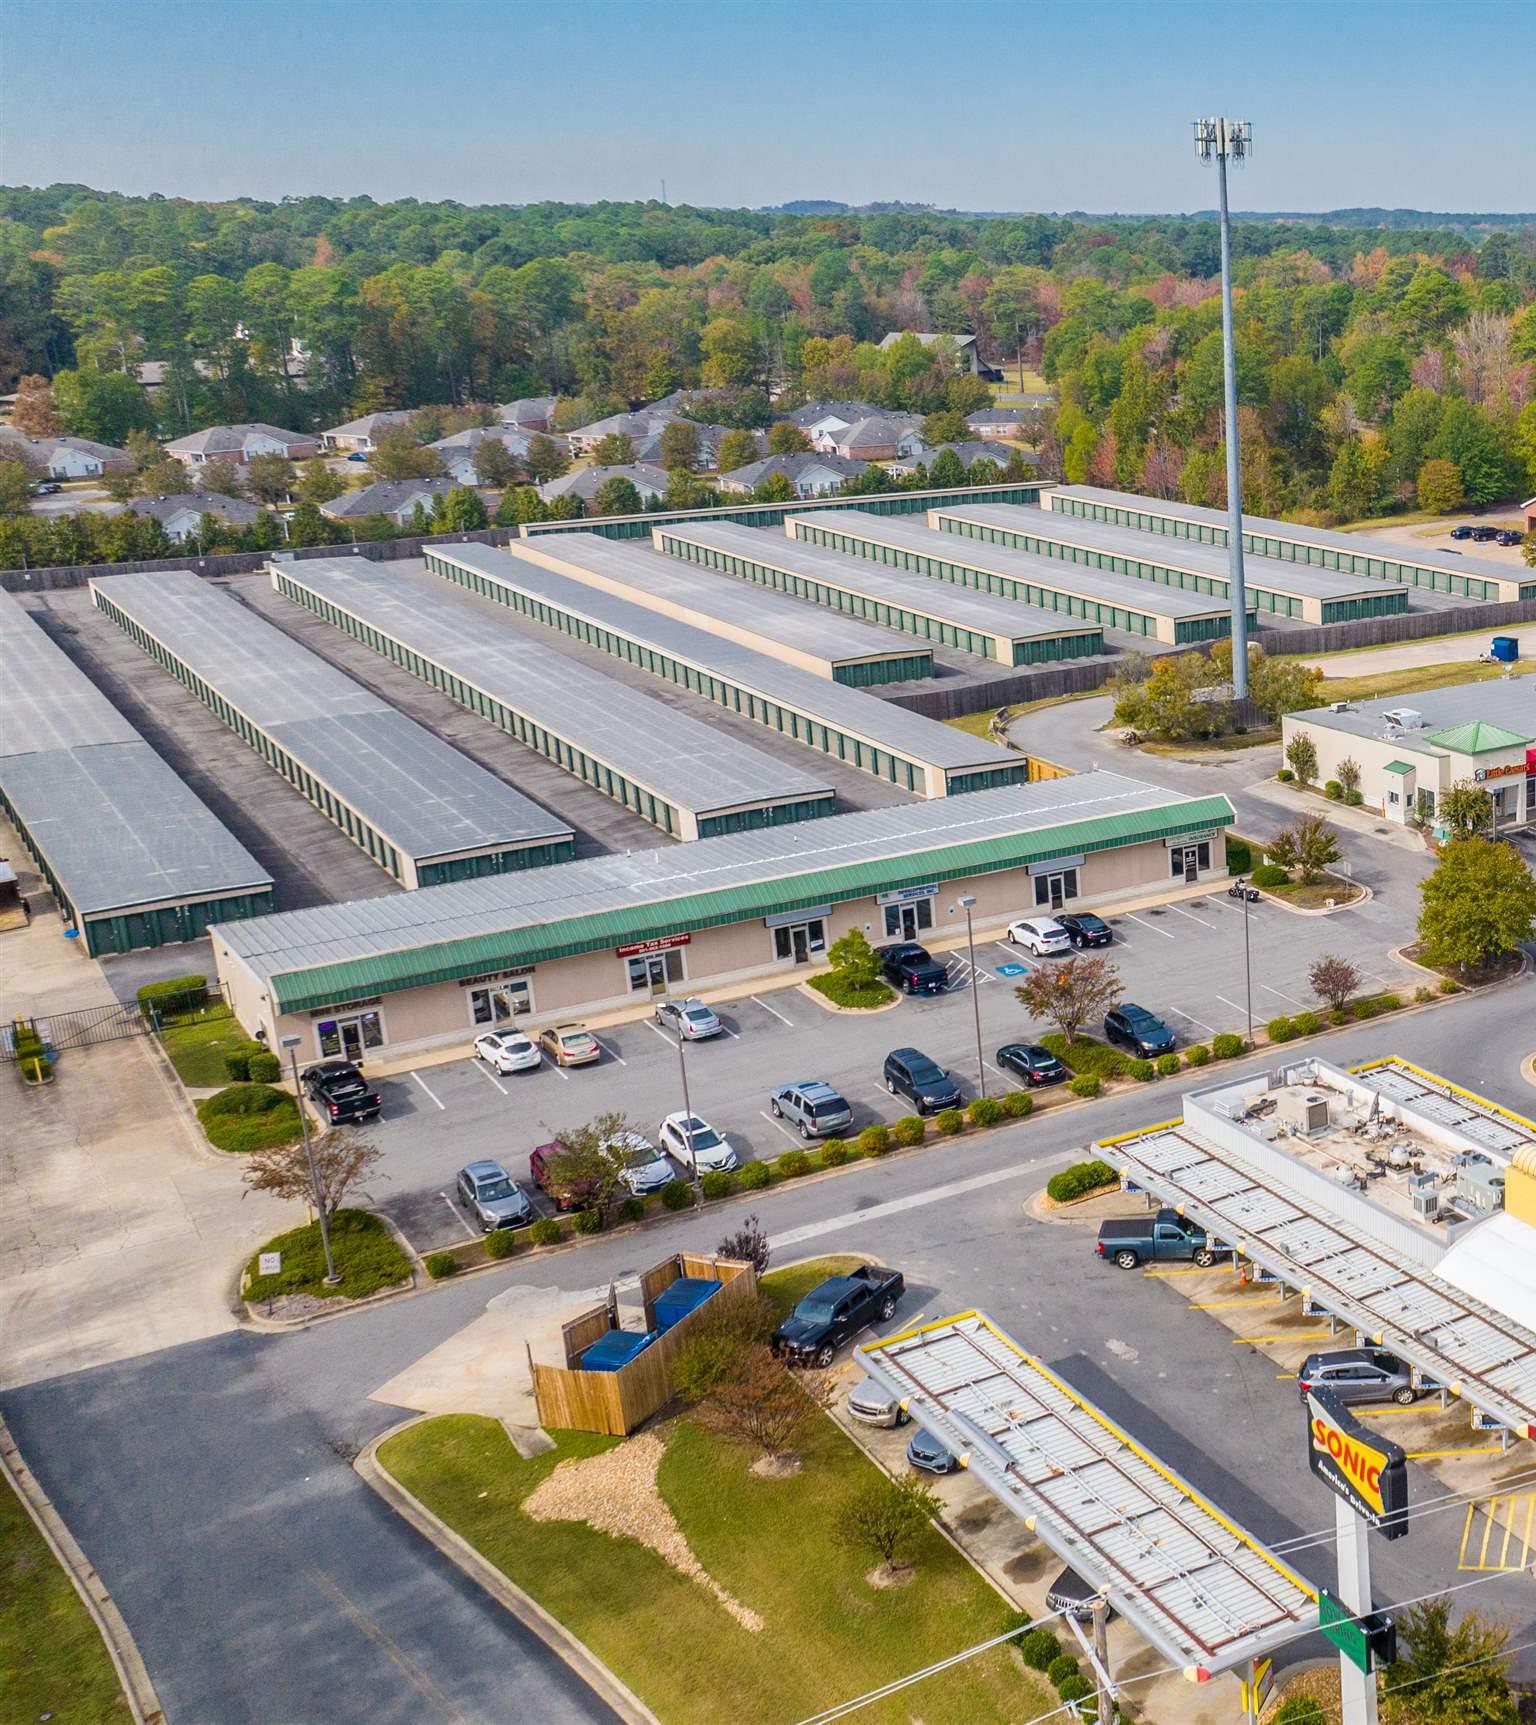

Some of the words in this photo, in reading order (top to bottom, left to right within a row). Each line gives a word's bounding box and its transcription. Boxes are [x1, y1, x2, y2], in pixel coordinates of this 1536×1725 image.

[619, 944, 645, 953] Income
[660, 934, 689, 945] Services
[459, 973, 499, 987] BEAUTY
[503, 966, 536, 978] SALON
[335, 996, 383, 1014] STORAGE
[1315, 1418, 1380, 1494] SONIC
[1317, 1459, 1350, 1496] America's
[1350, 1493, 1381, 1528] Drive-In
